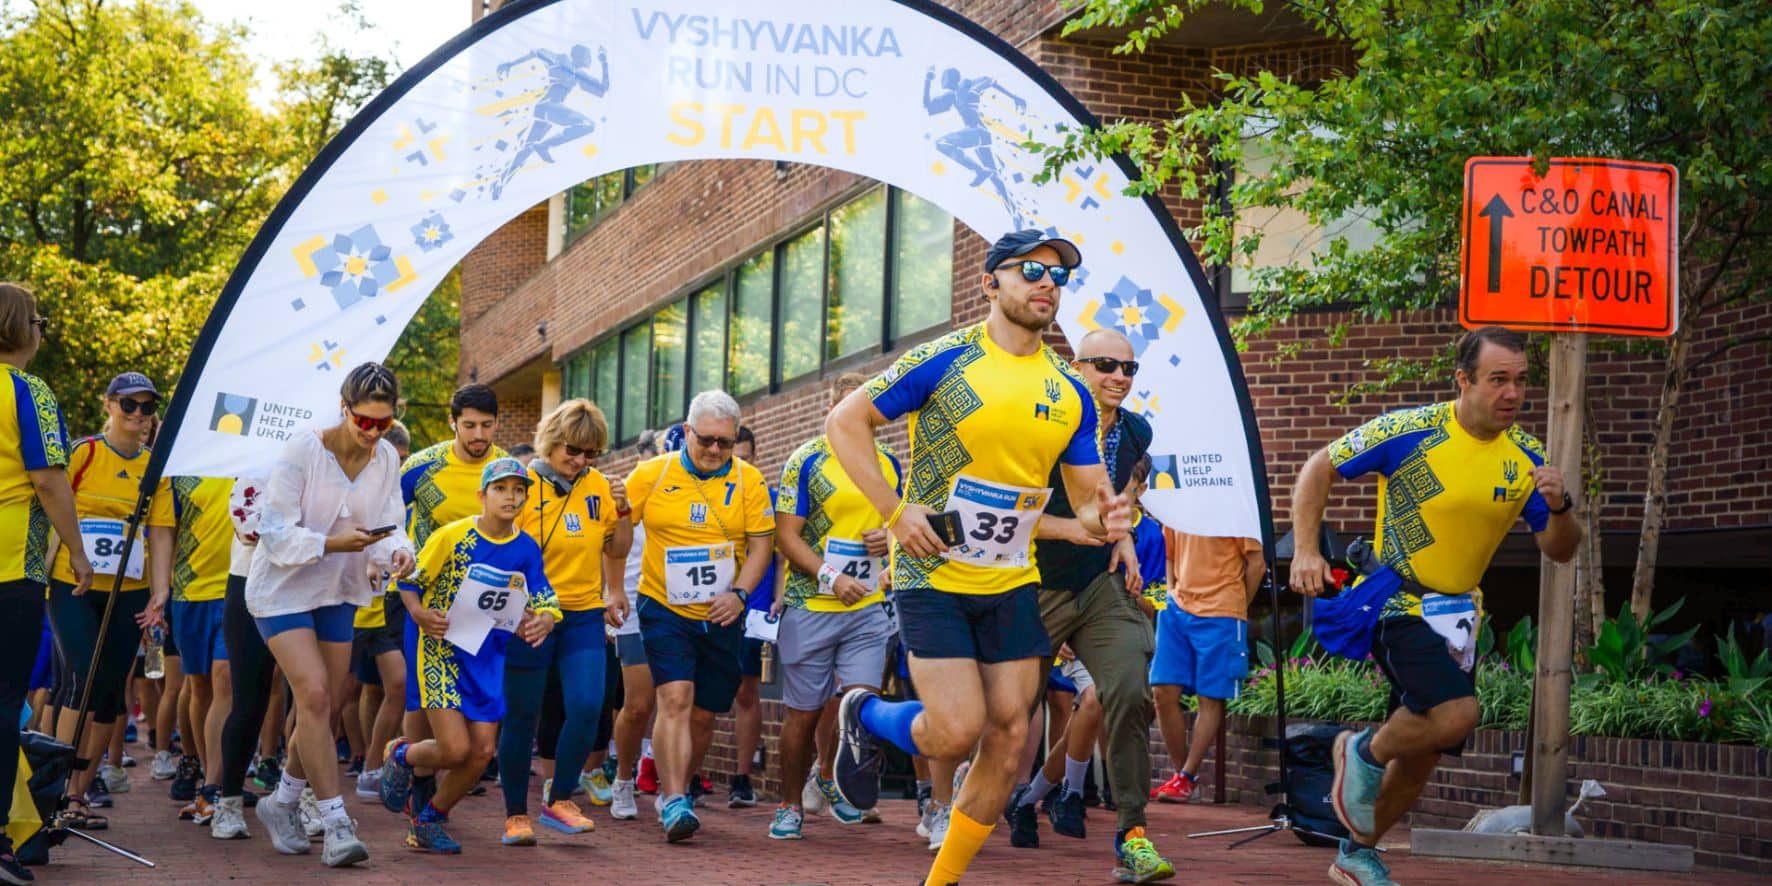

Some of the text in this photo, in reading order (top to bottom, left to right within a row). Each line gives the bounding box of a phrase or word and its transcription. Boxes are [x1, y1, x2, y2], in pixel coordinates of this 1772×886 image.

[631, 7, 904, 58] VYSHYVANKA
[667, 56, 869, 99] RUN IN DC
[665, 101, 869, 156] START
[1521, 187, 1664, 221] C&O CANAL
[1537, 226, 1646, 257] TOWPATH
[1529, 265, 1652, 304] DETOUR
[259, 414, 296, 429] HELP
[263, 402, 313, 420] UNITED
[1182, 454, 1222, 465] UNITED
[1183, 466, 1212, 475] HELP
[724, 482, 736, 506] 7
[1185, 477, 1234, 488] UKRAINE
[969, 511, 1019, 544] 33
[686, 564, 717, 587] 15
[842, 560, 872, 579] 42
[478, 590, 511, 612] 65
